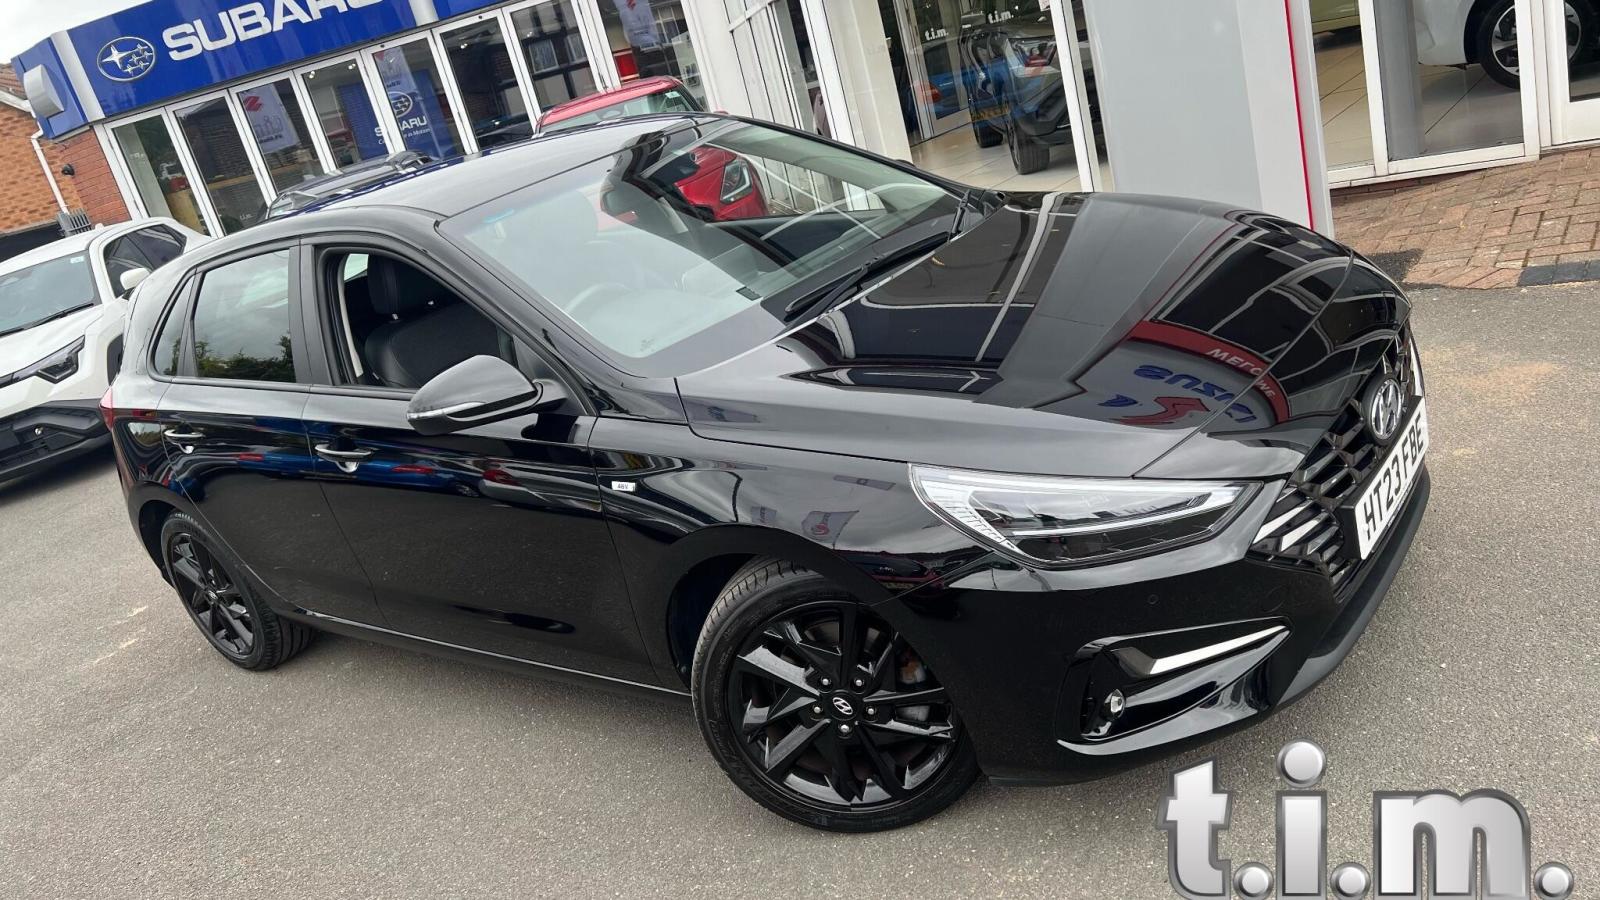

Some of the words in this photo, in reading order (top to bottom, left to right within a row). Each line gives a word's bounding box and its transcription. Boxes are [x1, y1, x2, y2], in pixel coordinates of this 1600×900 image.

[924, 28, 949, 41] t.i.m.
[1364, 454, 1402, 541] HT23
[1401, 411, 1424, 481] FBE
